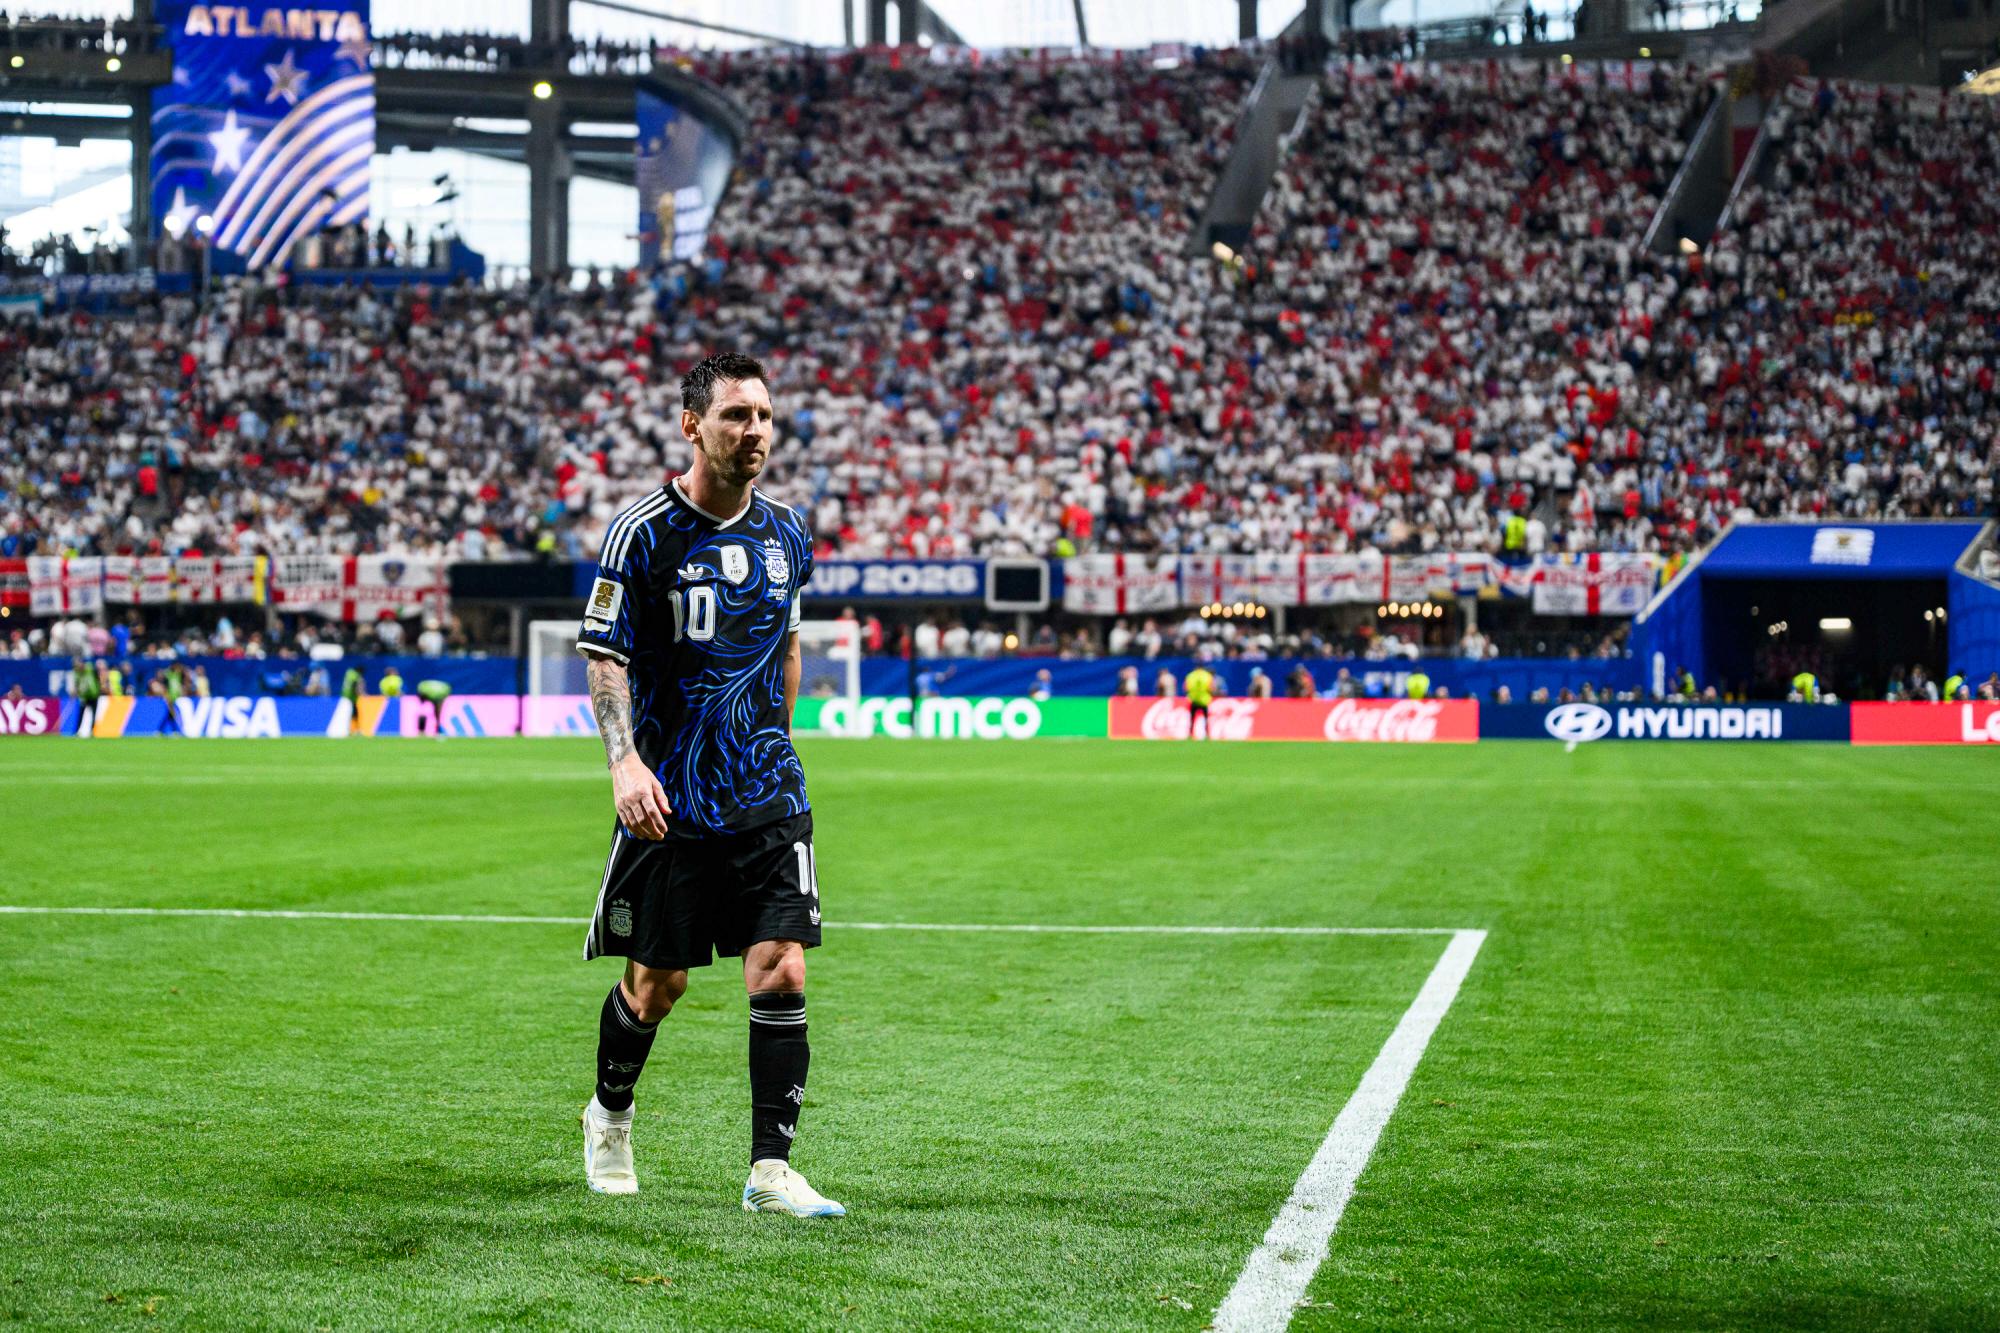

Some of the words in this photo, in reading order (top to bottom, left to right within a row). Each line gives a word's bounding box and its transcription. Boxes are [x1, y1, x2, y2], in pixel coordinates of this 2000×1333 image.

[185, 5, 366, 42] ATLANTA
[862, 564, 978, 594] 2026
[668, 586, 716, 643] 10
[175, 696, 282, 738] VISA
[819, 697, 1042, 739] aramco
[1617, 707, 1783, 738] HYUNDAI
